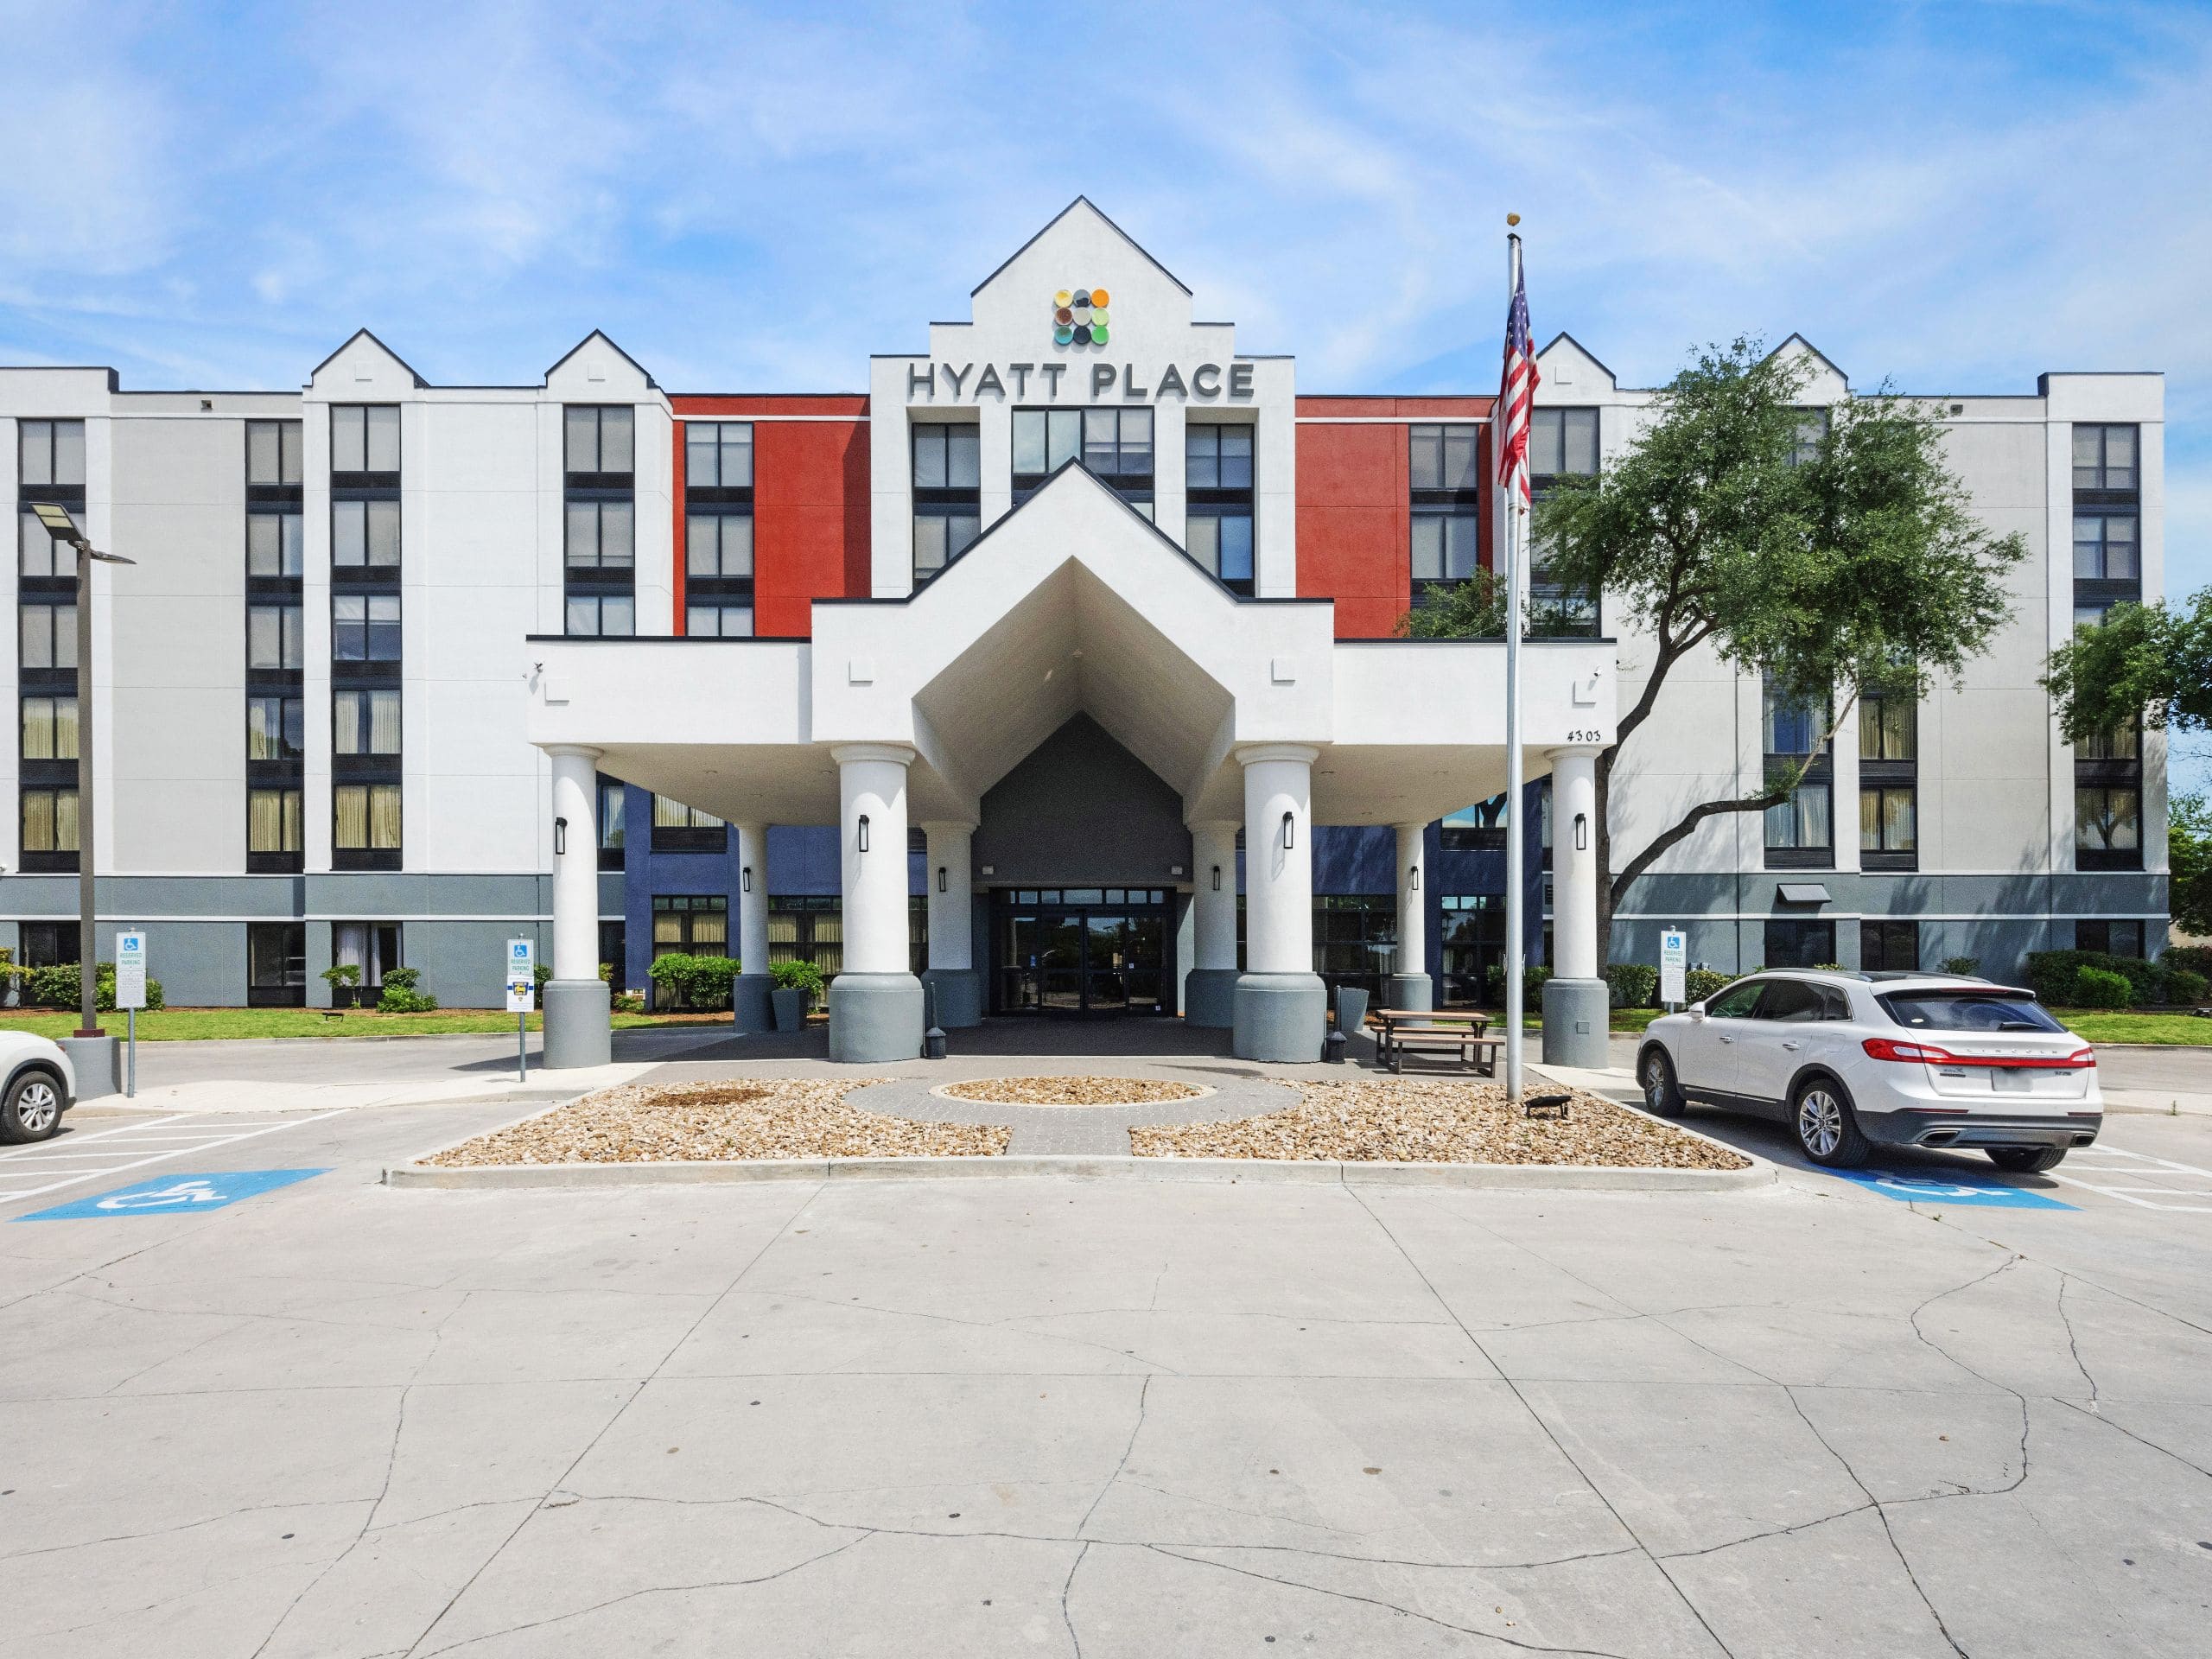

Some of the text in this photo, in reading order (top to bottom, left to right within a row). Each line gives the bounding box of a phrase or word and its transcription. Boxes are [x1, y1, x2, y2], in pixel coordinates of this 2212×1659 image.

[909, 363, 1255, 397] HYATT PLACE
[1567, 729, 1601, 741] 4303
